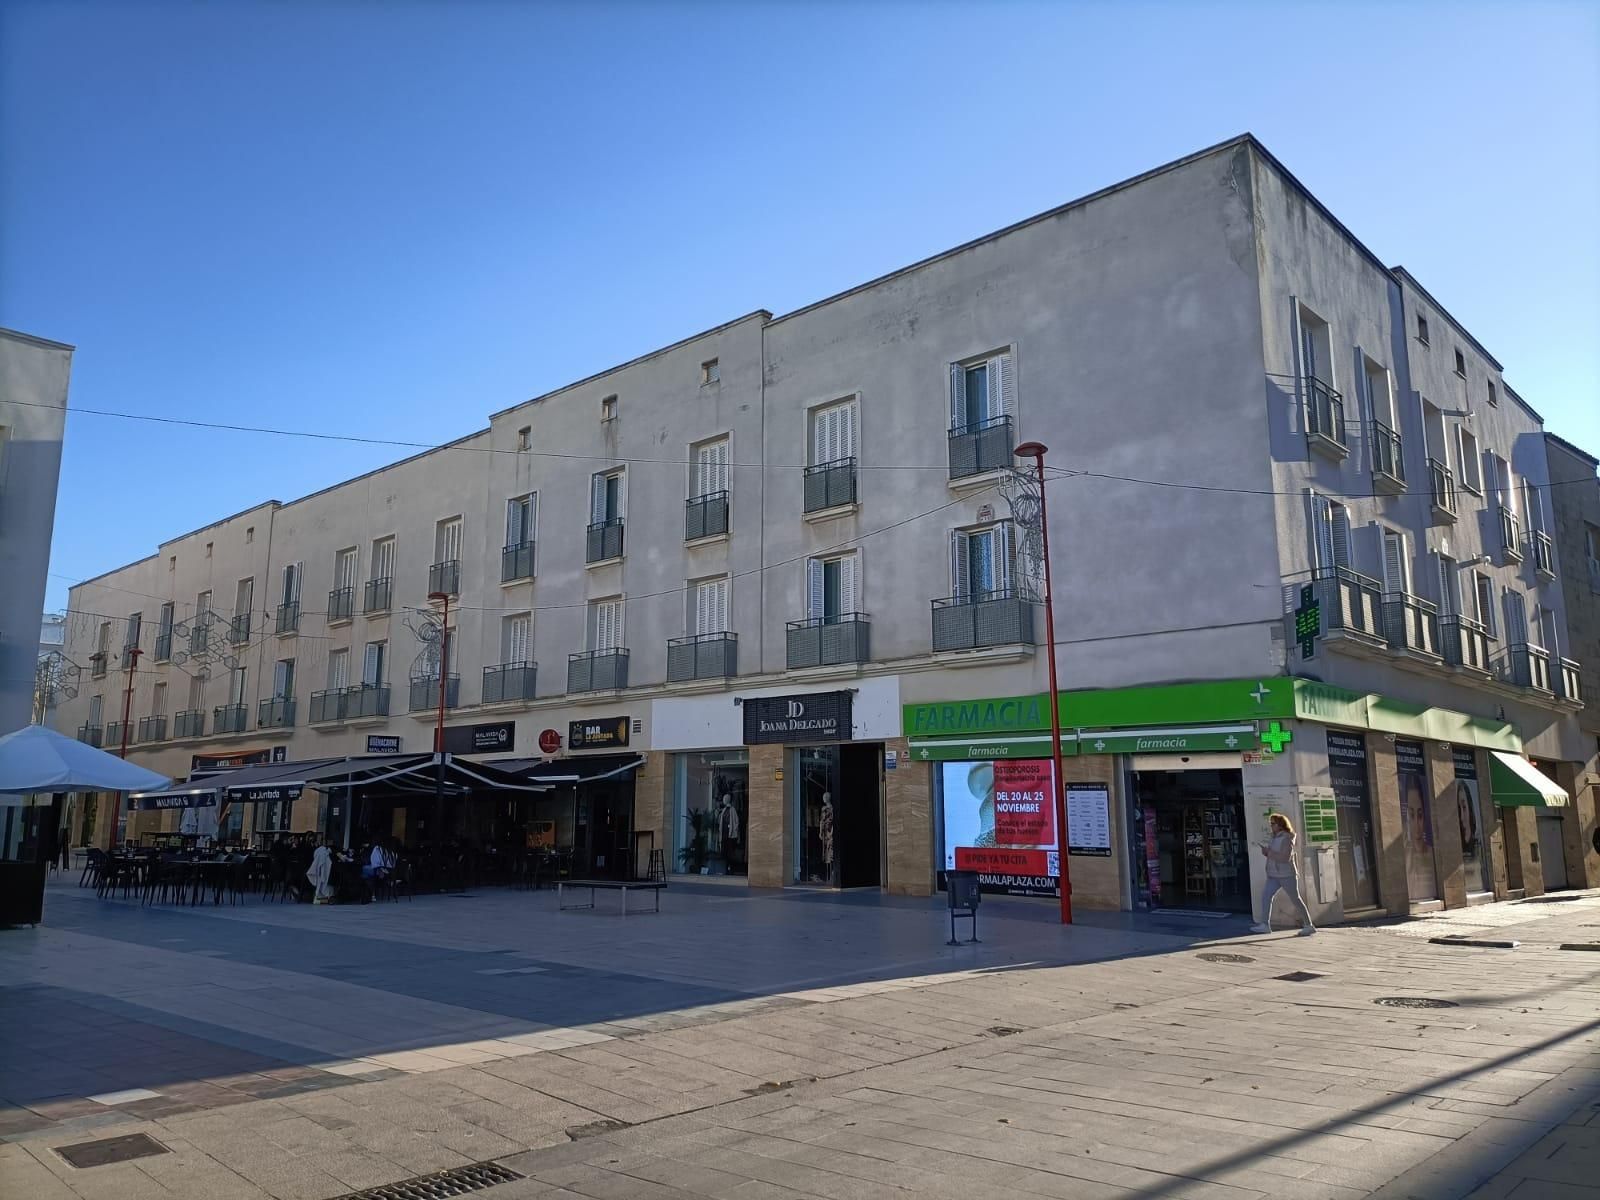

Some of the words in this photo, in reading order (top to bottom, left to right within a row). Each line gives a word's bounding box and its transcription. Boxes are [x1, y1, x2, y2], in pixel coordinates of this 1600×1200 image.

[785, 700, 804, 718] JD
[915, 699, 1040, 731] FARMACIA
[789, 718, 837, 730] DELGADO
[585, 725, 600, 735] BAR
[1136, 737, 1187, 750] farmacia
[967, 745, 1009, 758] farmacia
[249, 791, 257, 799] La
[996, 791, 1009, 801] DEL
[1011, 791, 1021, 801] 20
[1022, 791, 1032, 801] AL
[1034, 791, 1044, 801] 25
[996, 803, 1040, 813] NOVIEMBRE
[989, 855, 999, 864] YA
[1000, 855, 1009, 864] TU
[1010, 855, 1027, 864] CITA
